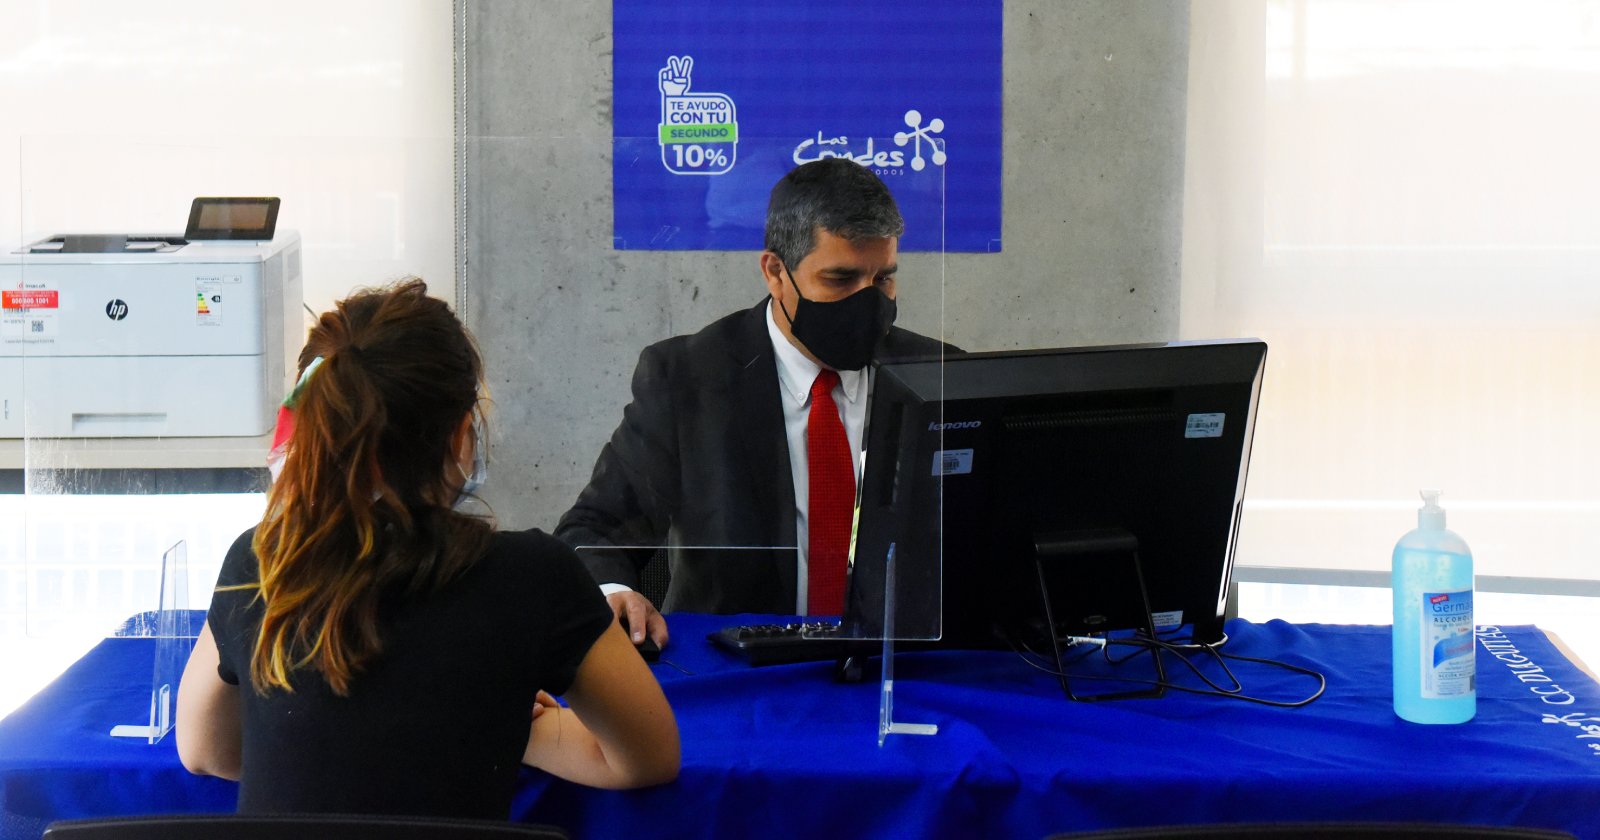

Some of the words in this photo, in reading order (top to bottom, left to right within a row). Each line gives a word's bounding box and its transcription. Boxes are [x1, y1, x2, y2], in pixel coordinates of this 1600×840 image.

[670, 101, 685, 111] TE
[686, 101, 727, 111] AYUDO
[670, 112, 706, 124] CON
[708, 111, 727, 124] TU
[670, 127, 729, 139] SEGUNDO
[817, 130, 849, 145] Las
[672, 144, 728, 168] 10%
[870, 168, 904, 176] ODOS
[108, 299, 126, 321] hp
[928, 420, 982, 431] lenovo
